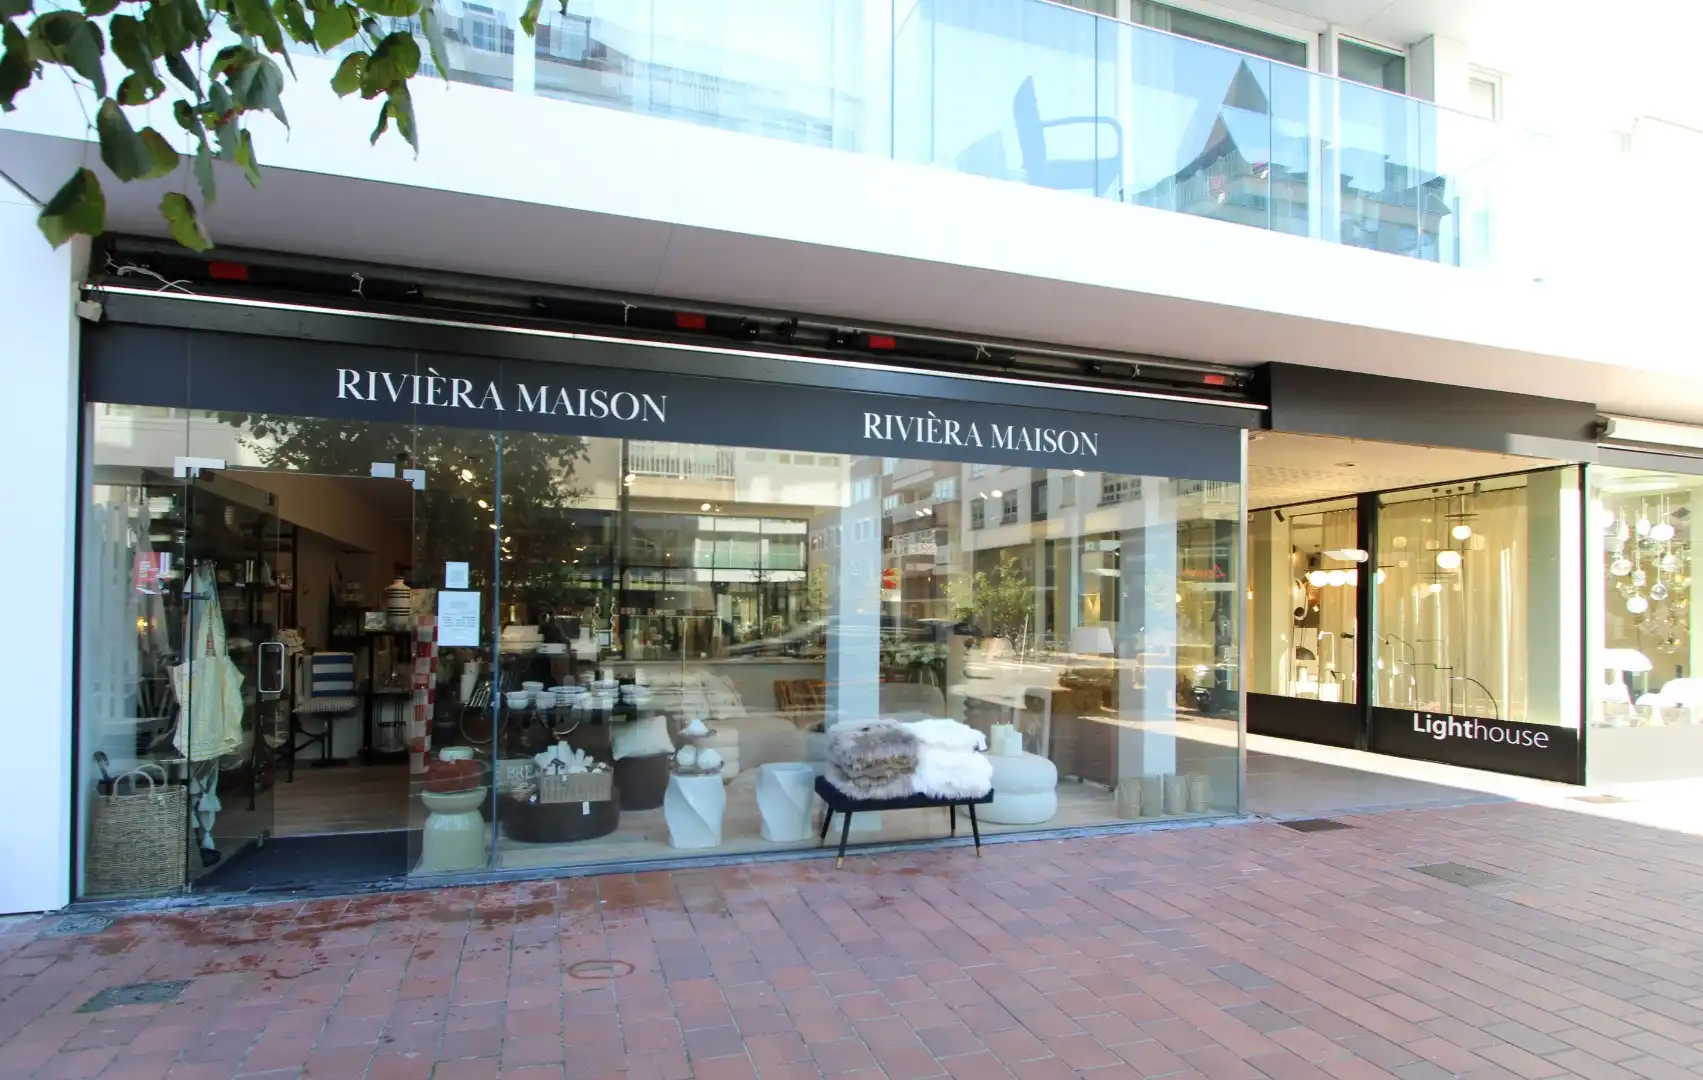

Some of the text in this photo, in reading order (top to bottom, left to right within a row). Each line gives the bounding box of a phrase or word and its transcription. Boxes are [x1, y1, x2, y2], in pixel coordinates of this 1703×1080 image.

[336, 367, 667, 423] RIVIÈRA MAISON
[863, 410, 1099, 456] RIVIÈRA MAISON
[1413, 712, 1549, 748] Lighthouse
